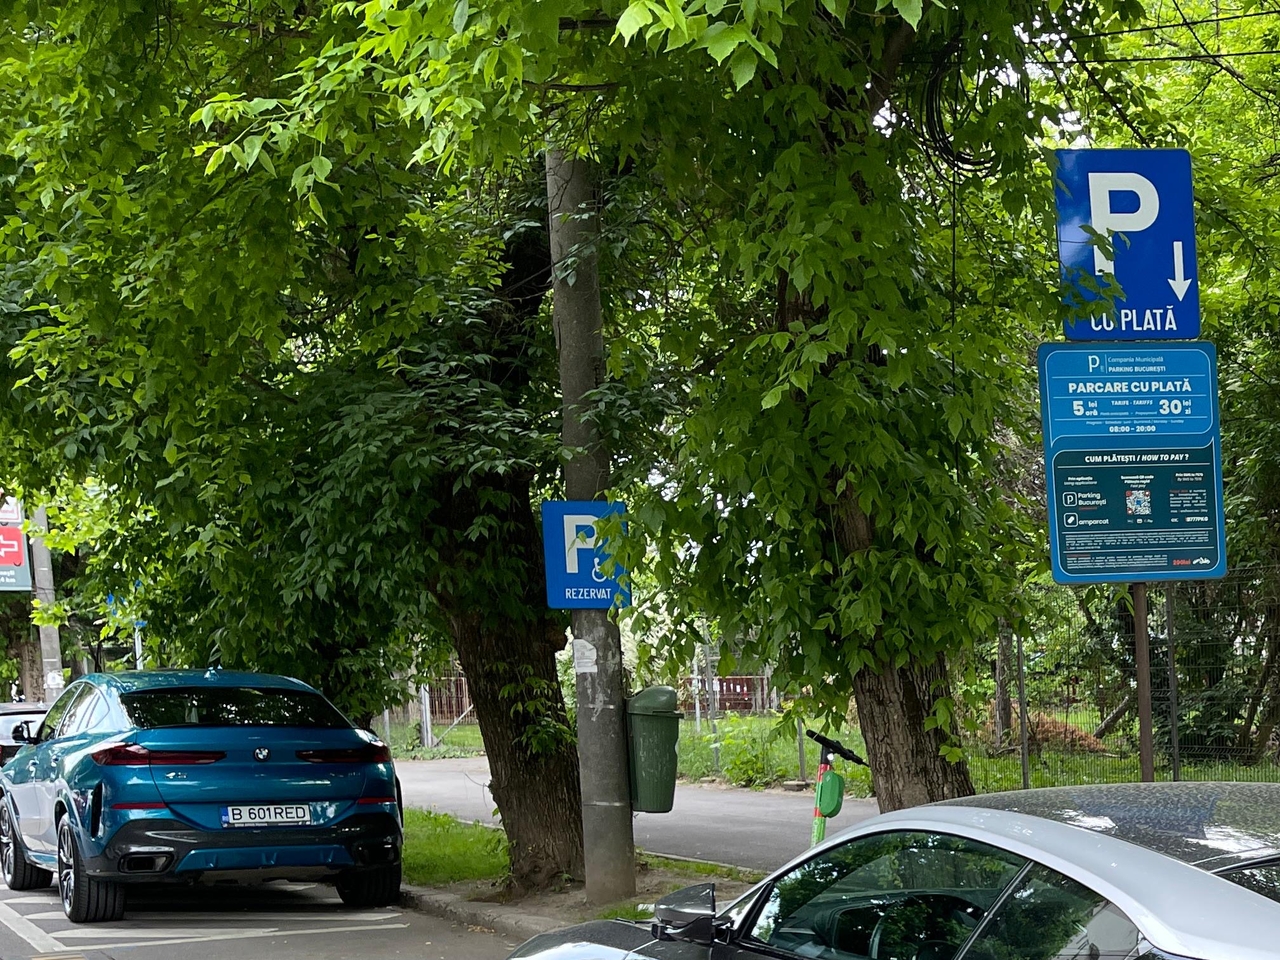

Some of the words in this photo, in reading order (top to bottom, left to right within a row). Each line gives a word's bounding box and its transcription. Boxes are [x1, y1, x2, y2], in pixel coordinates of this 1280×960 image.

[1088, 172, 1160, 276] P
[1121, 305, 1177, 331] PLATĂ
[1068, 382, 1129, 393] PARCARE
[1131, 381, 1149, 392] CU
[1151, 378, 1192, 392] PLATĂ
[1073, 401, 1084, 416] 5
[1159, 399, 1182, 415] 30
[1085, 455, 1102, 463] CUM
[563, 515, 603, 574] P
[565, 588, 611, 599] REZERVAT
[231, 808, 242, 820] B
